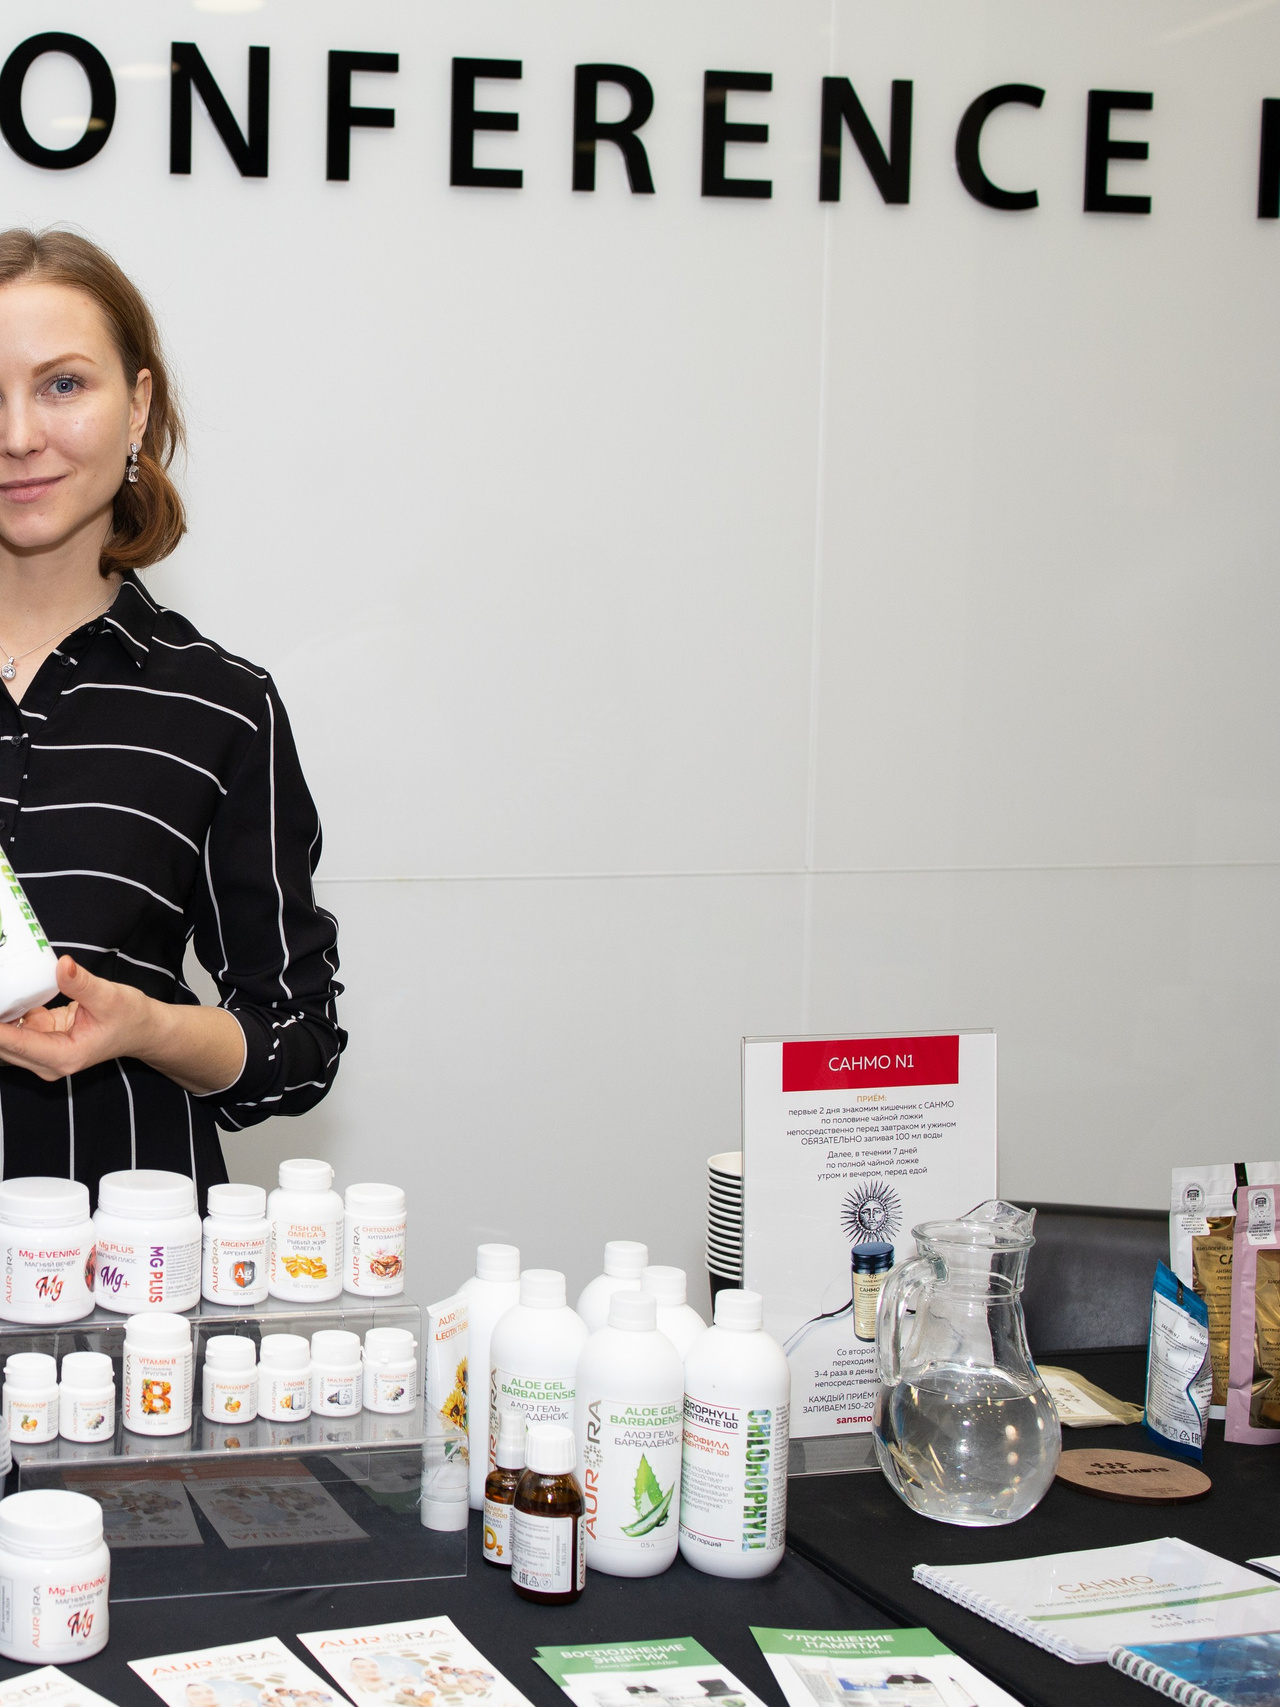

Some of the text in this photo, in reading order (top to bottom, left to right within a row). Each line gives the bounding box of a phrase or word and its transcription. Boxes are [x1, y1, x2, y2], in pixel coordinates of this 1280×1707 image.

[828, 1053, 915, 1072] САНМО N1
[788, 1108, 818, 1117] первые
[819, 1106, 825, 1115] 2
[825, 1107, 840, 1115] дня
[842, 1105, 879, 1114] знакомим
[880, 1103, 917, 1112] кишечник
[924, 1100, 955, 1109] САНМО
[832, 1115, 870, 1124] половине
[871, 1113, 898, 1122] чайной
[899, 1113, 924, 1121] ложки
[786, 1127, 854, 1137] непосредственно
[856, 1125, 880, 1134] перед
[880, 1123, 919, 1132] завтраком
[927, 1121, 957, 1131] ужином
[801, 1134, 863, 1146] ОБЯЗАТЕЛЬНО
[863, 1134, 894, 1143] запивая
[895, 1132, 910, 1141] 100
[923, 1131, 943, 1140] воды
[827, 1150, 854, 1160] Далее,
[861, 1149, 892, 1157] течении
[893, 1147, 898, 1155] 7
[899, 1147, 918, 1156] дней
[837, 1159, 866, 1169] полной
[867, 1158, 894, 1167] чайной
[895, 1156, 920, 1166] ложке
[817, 1172, 841, 1182] утром
[849, 1169, 883, 1178] вечером,
[884, 1167, 908, 1176] перед
[908, 1166, 928, 1175] едой
[290, 1224, 309, 1232] FISH
[98, 1240, 134, 1254] Mg PLUS
[220, 1239, 265, 1248] ARGENT-MAX
[19, 1248, 81, 1260] Mg-EVENING
[56, 1260, 76, 1268] ВЕЧЕР
[149, 1246, 164, 1303] MG PLUS
[235, 1267, 252, 1280] Ag
[35, 1274, 64, 1302] Mg
[836, 1347, 876, 1356] Со второй
[138, 1357, 170, 1366] VITAMIN
[832, 1358, 874, 1368] переходим
[814, 1370, 828, 1378] 3-4
[829, 1370, 848, 1380] раза
[855, 1368, 874, 1376] день
[510, 1377, 566, 1391] ALOE GEL
[815, 1378, 882, 1388] непосредственно
[141, 1379, 172, 1415] B
[501, 1384, 576, 1400] BARBADENSIS
[808, 1391, 874, 1403] КАЖДЫЙ ПРИЁМ
[536, 1405, 561, 1413] ГЕЛЬ
[625, 1405, 678, 1416] ALOE GEL
[803, 1402, 875, 1414] ЗАПИВАЕМ 150-20
[524, 1411, 569, 1422] АДЕНСИС
[610, 1411, 683, 1427] BARBADENSIS
[836, 1415, 873, 1425] sansmo
[723, 1421, 738, 1430] 100
[623, 1429, 674, 1439] АЛОЭ ГЕЛЬ
[614, 1435, 680, 1449] БАРБАДЕНСИС
[716, 1449, 730, 1457] 100
[584, 1399, 604, 1541] AURORA
[697, 1537, 722, 1549] порций
[48, 1574, 107, 1596] Mg-EVENING
[1057, 1575, 1154, 1594] САНМО
[31, 1585, 41, 1648] AURORA
[67, 1608, 95, 1638] Mg
[782, 1633, 895, 1644] УЛУЧШЕНИЕ
[560, 1643, 687, 1660] ВОСПОЛНЕНИЕ
[805, 1641, 880, 1650] ПАМЯТИ
[590, 1652, 669, 1665] ЭНЕРГИИ
